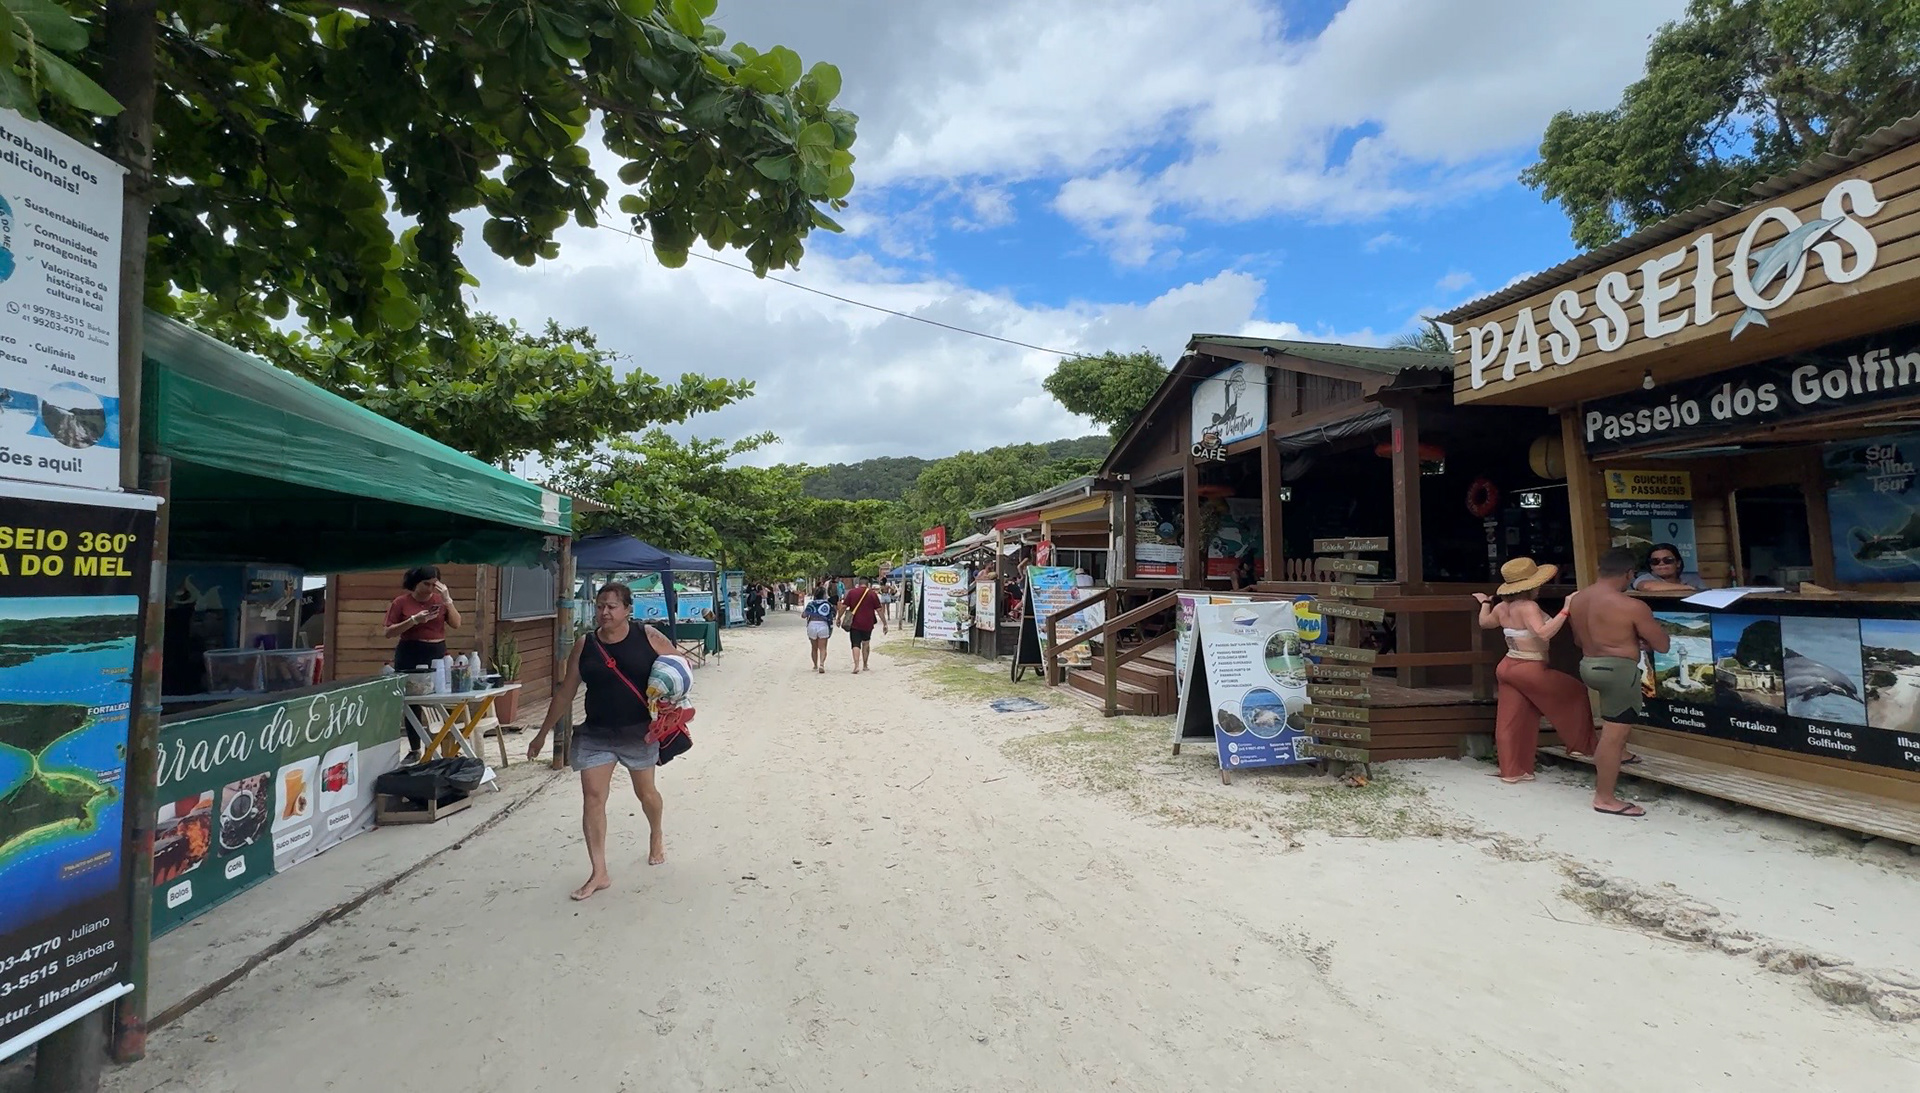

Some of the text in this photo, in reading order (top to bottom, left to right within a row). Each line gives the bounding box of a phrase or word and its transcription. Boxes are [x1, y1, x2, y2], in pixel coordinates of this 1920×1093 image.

[0, 149, 80, 195] dicionais!
[71, 163, 99, 185] dos
[24, 198, 110, 242] Sustentabilidade
[34, 224, 98, 257] Comunidade
[33, 238, 98, 269] protagonista
[41, 259, 108, 292] Valorização da
[1466, 178, 1887, 391] PASSEIOS
[46, 274, 104, 301] história e da
[46, 286, 103, 312] cultura local
[22, 303, 31, 311] 41
[33, 304, 85, 328] 99783-5515
[22, 315, 31, 323] 41
[33, 316, 85, 338] 99203-4770
[34, 343, 76, 361] Culinária
[51, 363, 106, 384] Aulas de surf
[1586, 394, 1700, 443] Passeio
[1711, 377, 1779, 422] dos
[1191, 444, 1227, 462] CAFÉ
[1865, 443, 1898, 460] Sul
[38, 456, 83, 473] aqui!
[1879, 458, 1915, 476] Ilha
[1633, 474, 1682, 485] GUICHÊ DE
[1873, 476, 1909, 493] Tour
[1631, 485, 1686, 496] PASSAGENS
[0, 526, 68, 551] SEIO
[20, 554, 64, 577] DO
[73, 556, 132, 577] MEL
[1316, 602, 1371, 618] Encantadas
[87, 702, 130, 715] FORTALEZA
[1669, 704, 1705, 717] Farol das
[260, 706, 303, 754] da
[305, 693, 369, 743] Ester
[1671, 716, 1707, 728] Conchas
[1729, 717, 1778, 734] Fortaleza
[1834, 728, 1853, 739] dos
[1897, 737, 1920, 749] Ilha
[1807, 736, 1857, 752] Golfinhos
[329, 811, 351, 826] Bebidas
[275, 830, 312, 851] Suco Natural
[227, 861, 243, 873] Café
[169, 886, 189, 901] Bolos
[68, 917, 110, 942] Juliano
[1, 939, 115, 997] 3-5515 Bárbara
